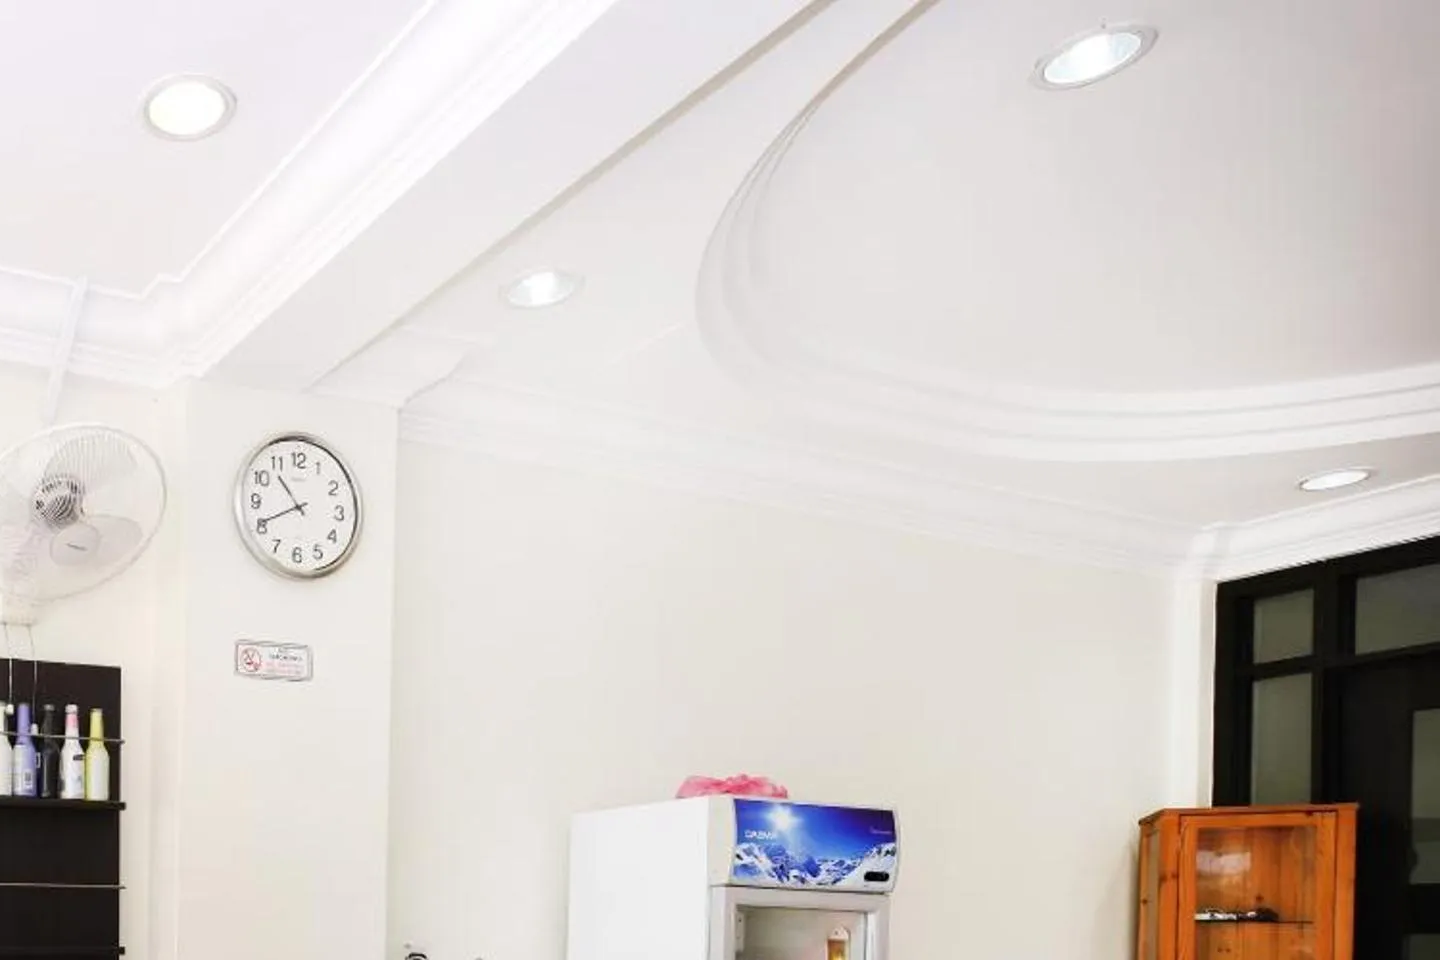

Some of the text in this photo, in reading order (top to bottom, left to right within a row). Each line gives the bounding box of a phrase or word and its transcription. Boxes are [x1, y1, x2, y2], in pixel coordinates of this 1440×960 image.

[271, 456, 284, 472] 11
[291, 452, 306, 469] 12
[315, 461, 321, 475] 1
[254, 470, 270, 487] 10
[327, 480, 339, 496] 2
[250, 492, 262, 509] 9
[334, 504, 345, 521] 3
[326, 528, 337, 544] 4
[271, 539, 281, 554] 7
[291, 546, 302, 563] 6
[312, 543, 324, 560] 5
